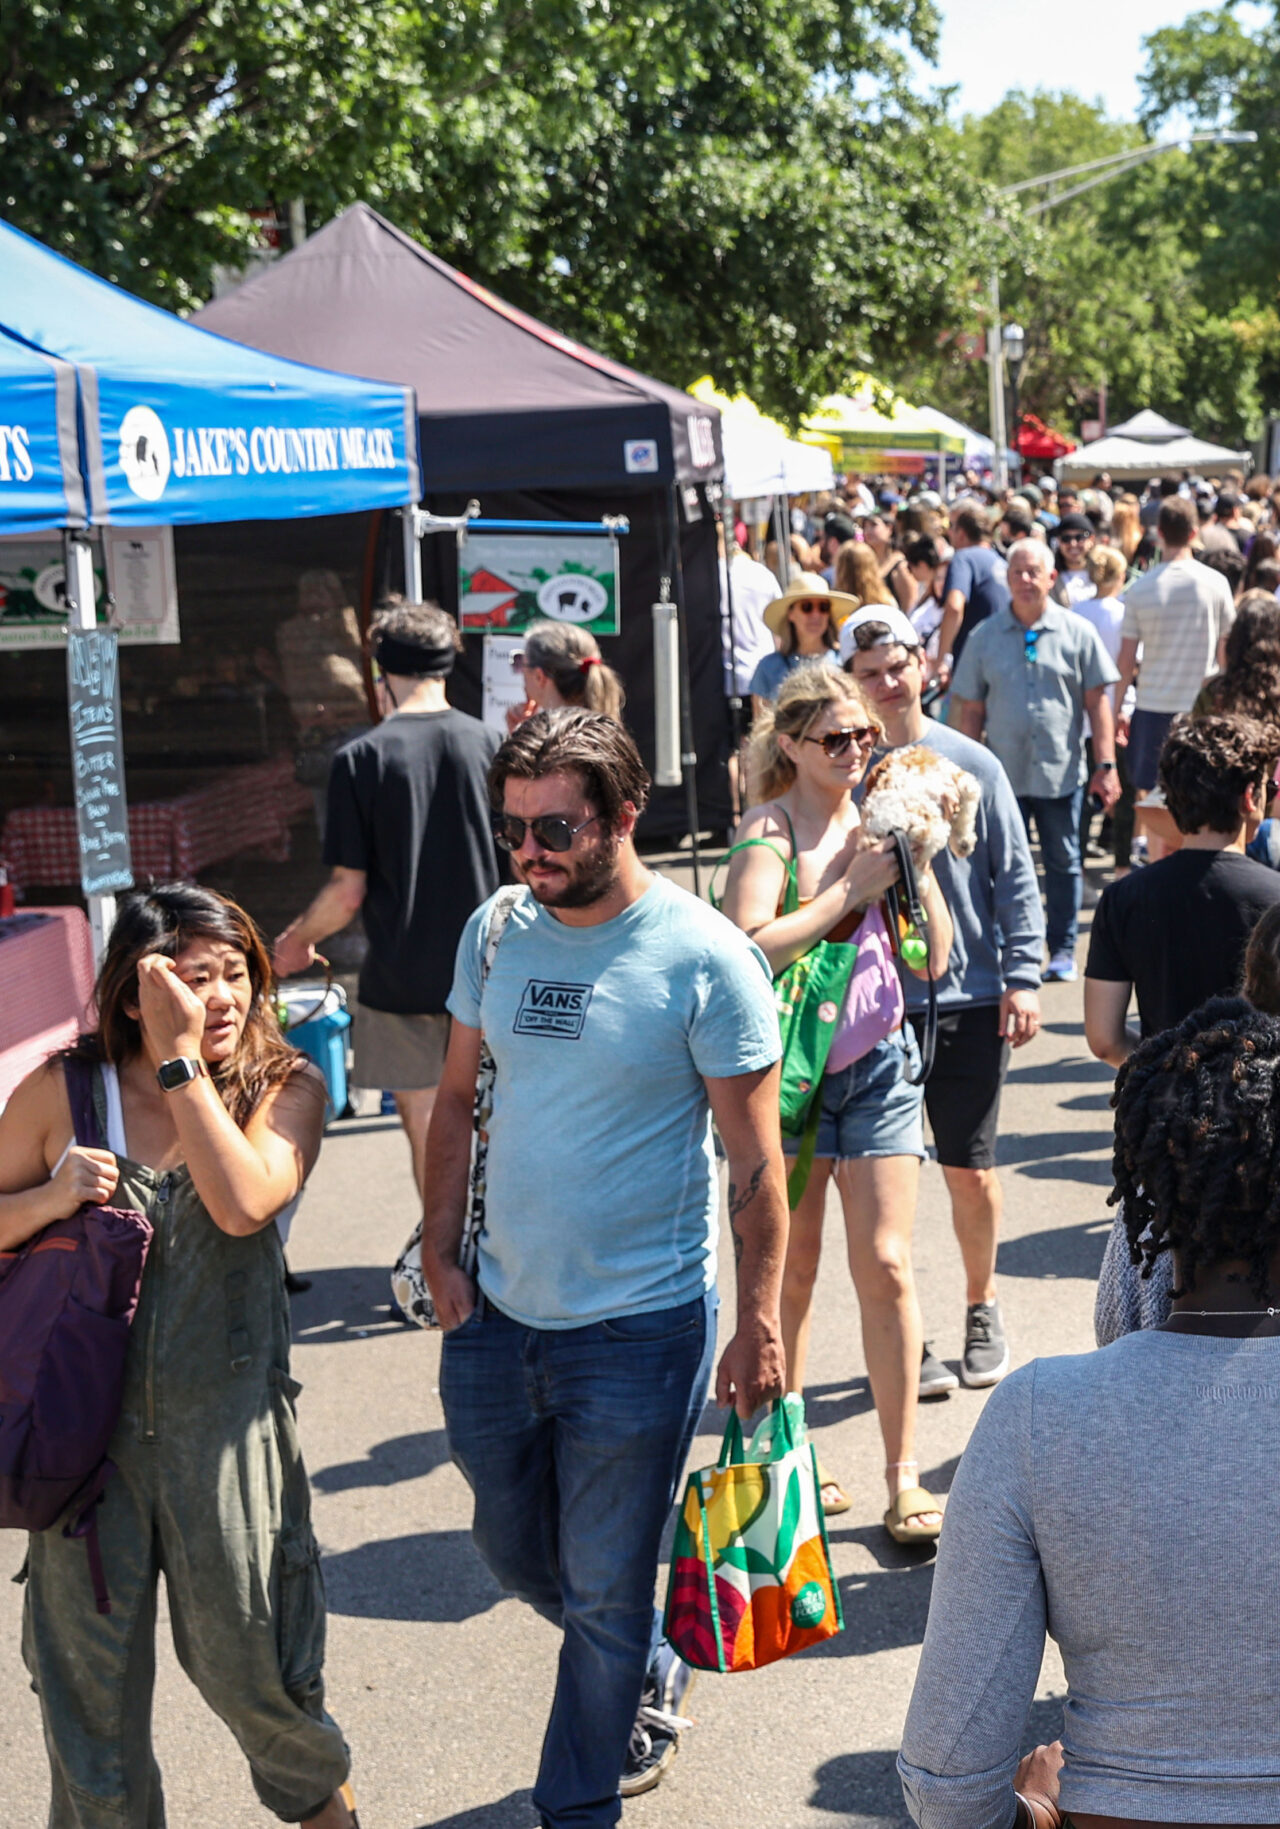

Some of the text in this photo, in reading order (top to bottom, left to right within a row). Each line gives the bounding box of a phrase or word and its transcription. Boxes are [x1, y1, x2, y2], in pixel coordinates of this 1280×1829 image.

[173, 426, 396, 478] JAKE'S COUNTRY MEATS
[531, 985, 586, 1010] VANS
